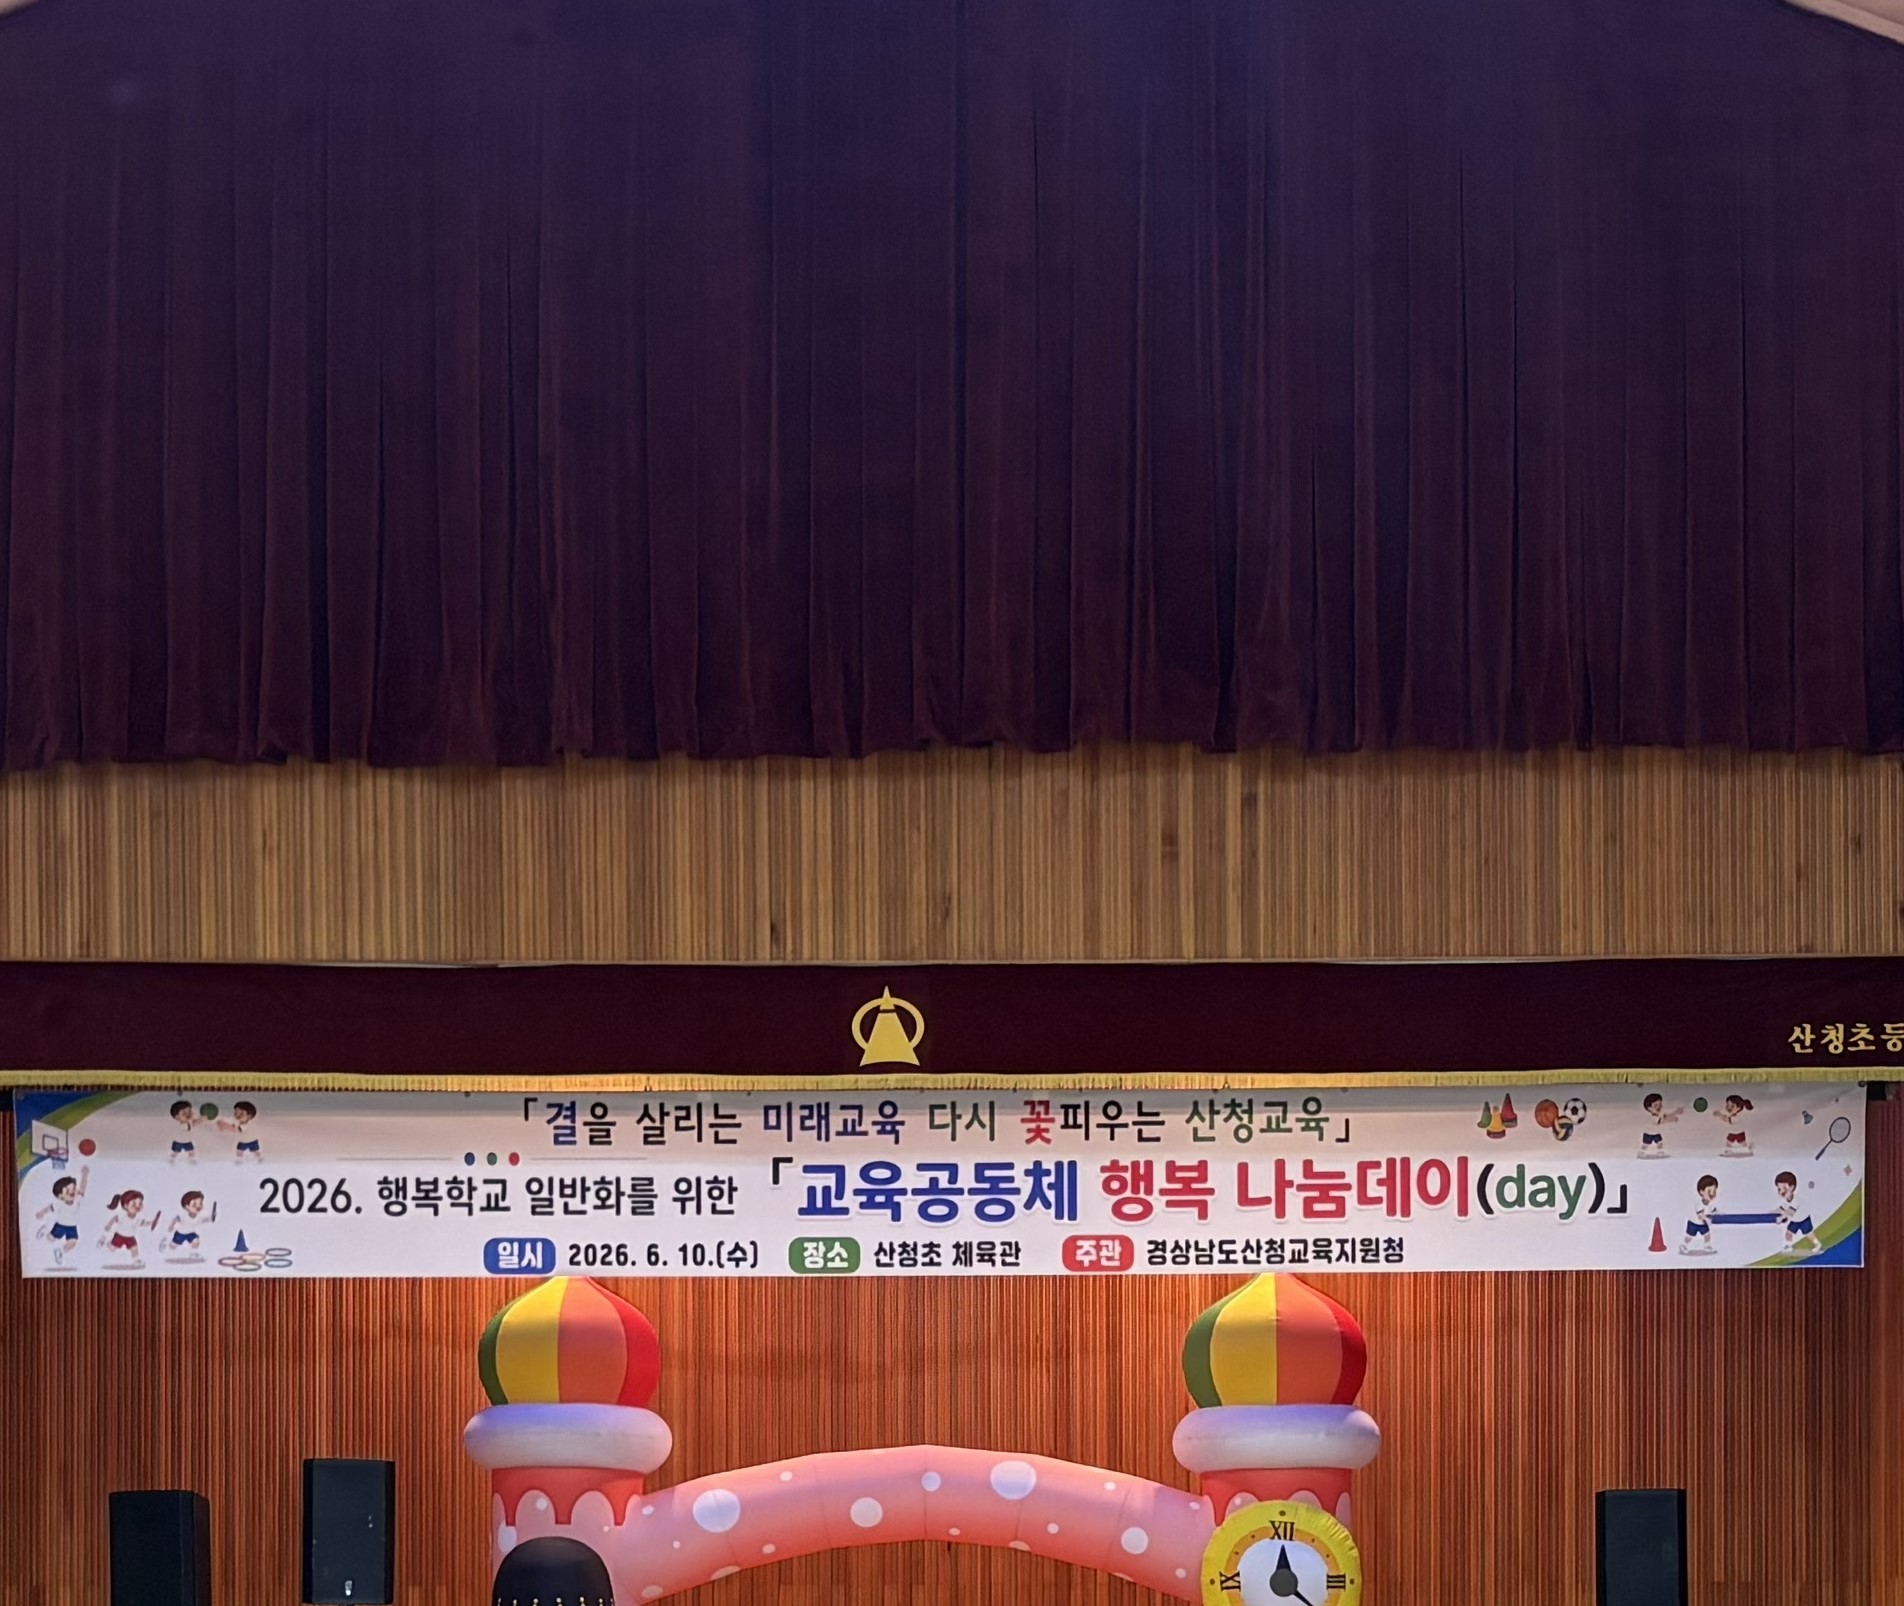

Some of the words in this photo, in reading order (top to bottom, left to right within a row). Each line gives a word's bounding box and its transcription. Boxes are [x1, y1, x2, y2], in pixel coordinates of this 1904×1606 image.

[635, 1101, 743, 1146] 살리는
[762, 1099, 906, 1145] 미래교육
[928, 1100, 996, 1142] 다시
[1019, 1099, 1166, 1145] 꽃피우는
[259, 1177, 363, 1214] 2026.
[376, 1175, 512, 1217] 행복학교
[525, 1175, 659, 1217] 일반화를
[671, 1175, 739, 1216] 위한
[1099, 1158, 1216, 1223] 행복
[497, 1240, 544, 1270] 일시
[567, 1242, 637, 1268] 2026.
[646, 1242, 669, 1267] 6.
[802, 1240, 850, 1270] 장소
[873, 1240, 942, 1269] 산청초
[952, 1240, 1022, 1268] 체육관
[1074, 1238, 1122, 1268] 주관
[1146, 1236, 1405, 1267] 경상남도산청교육지원청
[1268, 1519, 1295, 1542] XII
